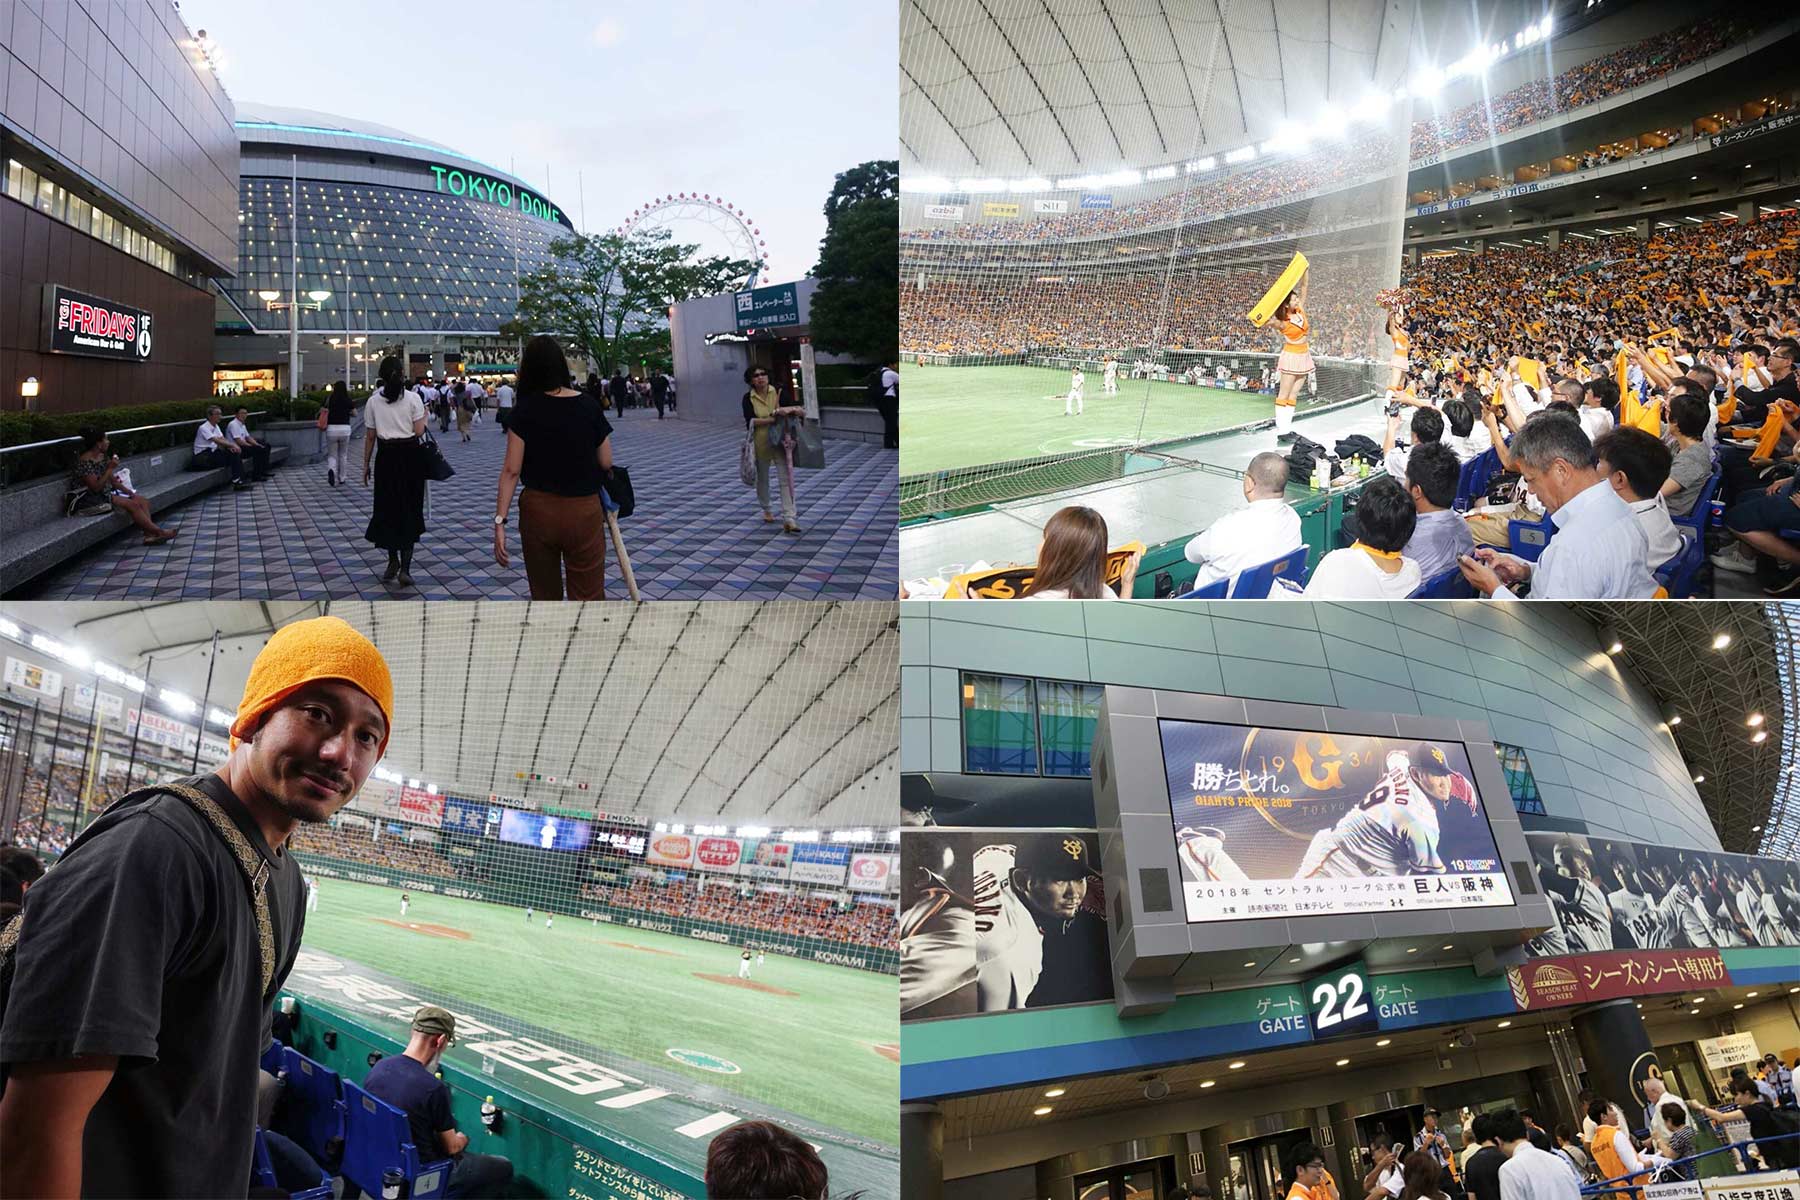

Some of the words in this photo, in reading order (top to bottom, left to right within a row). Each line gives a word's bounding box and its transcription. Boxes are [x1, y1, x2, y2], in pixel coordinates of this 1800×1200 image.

[1724, 125, 1767, 143] シーズンシート
[1768, 115, 1794, 130] 販売中
[430, 165, 511, 207] TOKYO
[520, 191, 560, 223] DOME
[736, 292, 753, 312] 西
[69, 300, 136, 342] FRIDAYS
[141, 315, 151, 330] 1F
[73, 334, 100, 347] American
[100, 338, 110, 348] Bar
[1529, 532, 1536, 543] 5
[1292, 733, 1346, 791] G
[497, 795, 526, 807] ENEOS
[1195, 794, 1235, 807] GIANTS
[1238, 796, 1269, 808] PRIDE
[1271, 797, 1293, 808] 2018
[1302, 802, 1346, 817] TOKYO
[606, 814, 636, 824] ENEOS
[1450, 859, 1465, 871] 19
[1196, 887, 1251, 898] 2018年
[1223, 906, 1236, 914] 主催
[1295, 901, 1334, 911] 日本テレビ
[581, 909, 612, 922] Canon
[691, 928, 729, 943] CASIO
[814, 950, 866, 969] KONAMI
[1375, 983, 1413, 1001] ゲート
[1536, 986, 1560, 995] SEASON
[1561, 984, 1578, 993] SEAT
[1546, 992, 1574, 1002] OWNERS
[1256, 995, 1301, 1016] ゲート
[1312, 973, 1369, 1030] 22
[1379, 1001, 1419, 1018] GATE
[1259, 1015, 1305, 1035] GATE
